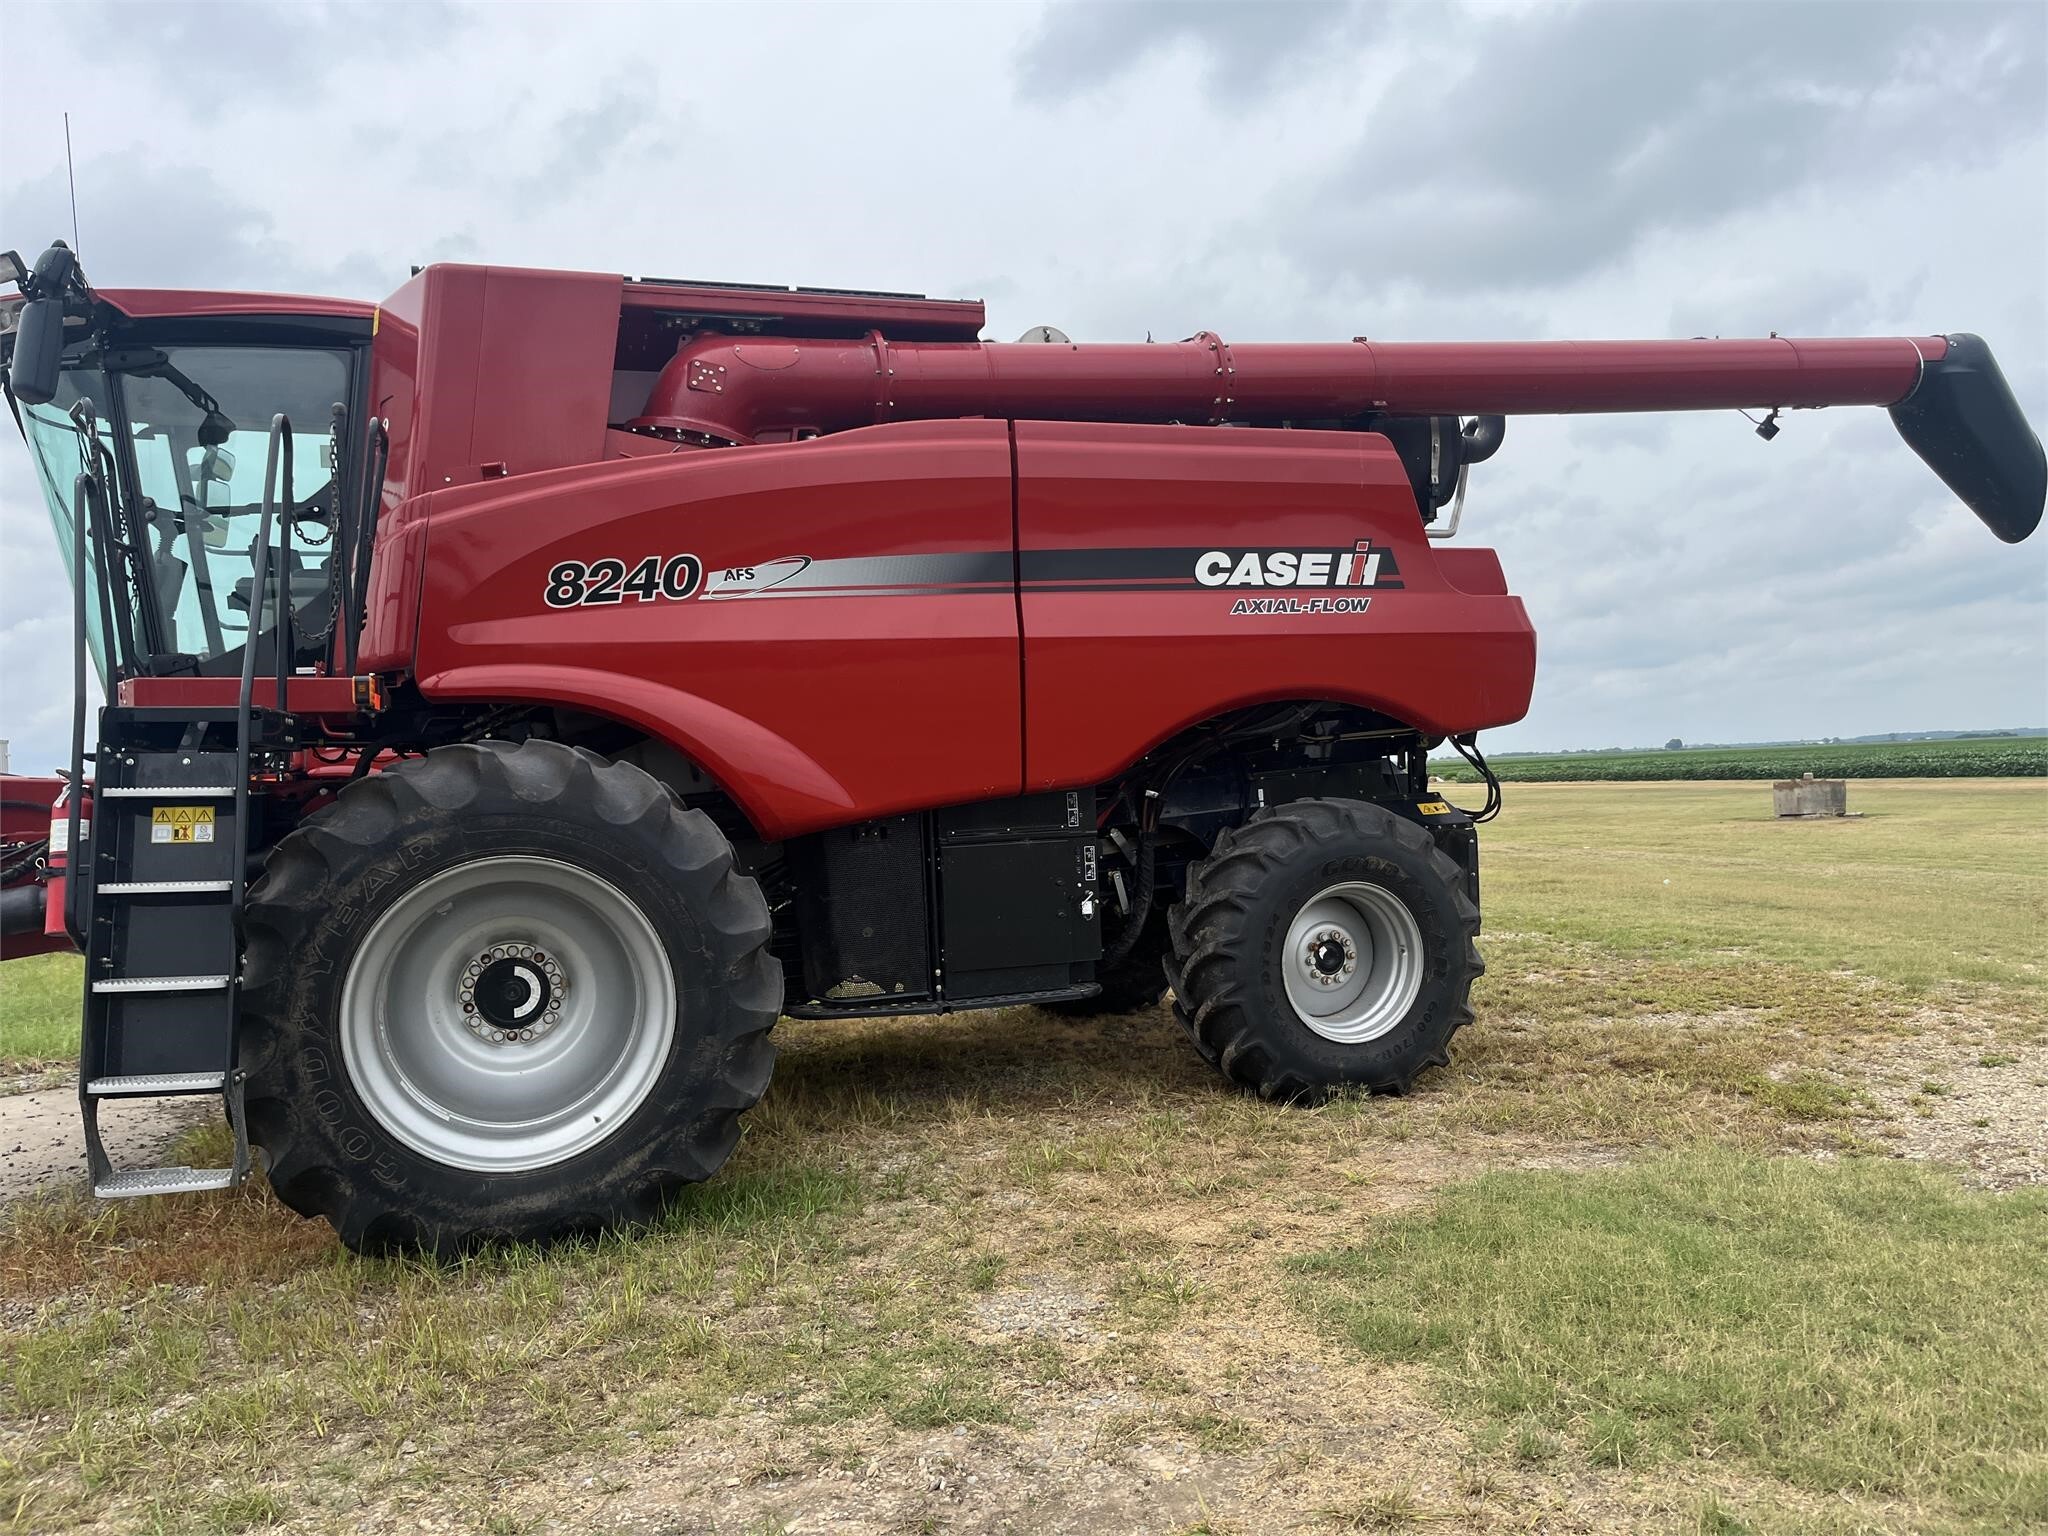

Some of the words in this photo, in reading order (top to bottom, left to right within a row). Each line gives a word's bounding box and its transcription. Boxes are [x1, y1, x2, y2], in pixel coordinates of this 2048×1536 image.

[544, 553, 702, 609] 8240
[723, 567, 755, 582] AFS
[1194, 551, 1333, 587] CASE
[1230, 597, 1371, 615] AXIAL-FLOW
